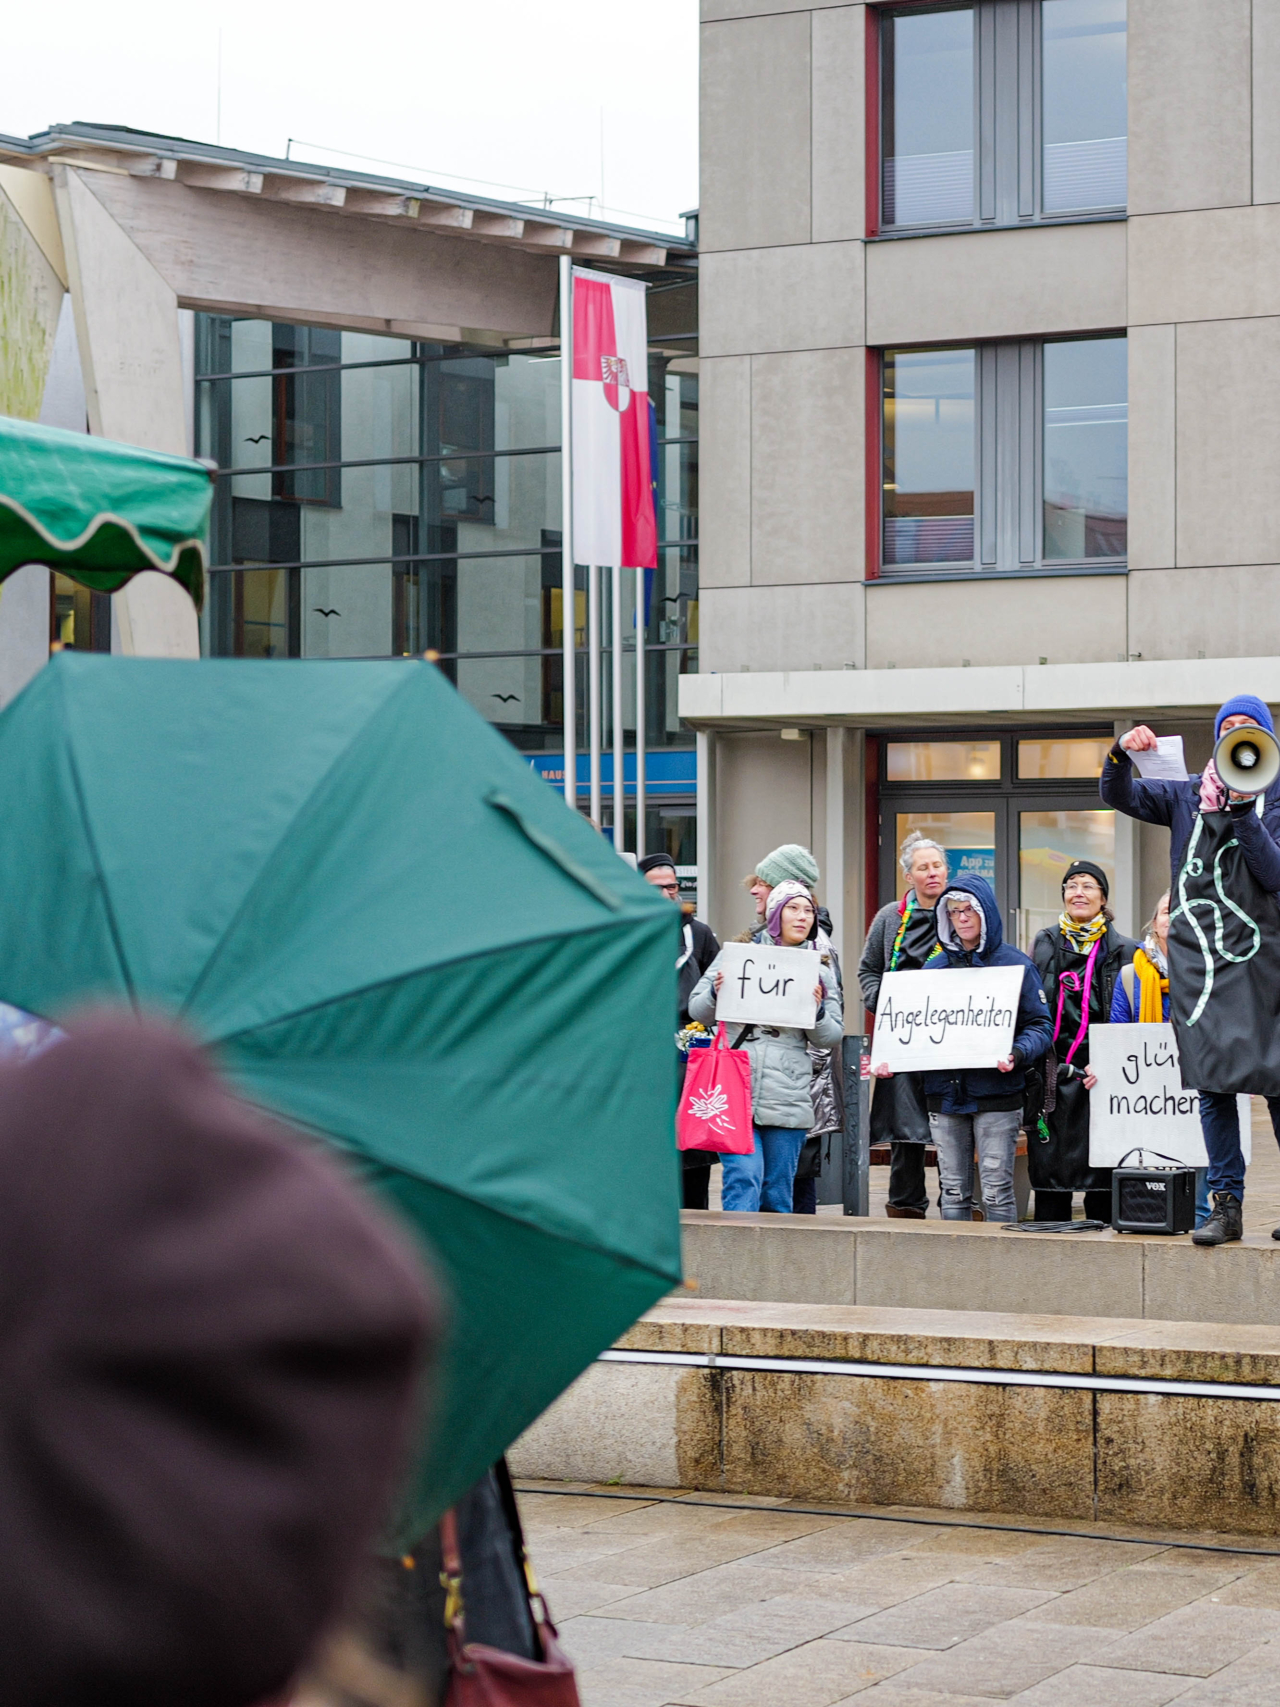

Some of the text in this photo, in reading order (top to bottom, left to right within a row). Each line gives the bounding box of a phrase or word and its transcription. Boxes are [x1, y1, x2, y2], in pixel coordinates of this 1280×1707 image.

[960, 855, 983, 869] App
[737, 958, 795, 999] für
[877, 995, 1013, 1045] Angelegenheiten
[1122, 1041, 1175, 1085] glü
[1145, 1181, 1166, 1191] VOX
